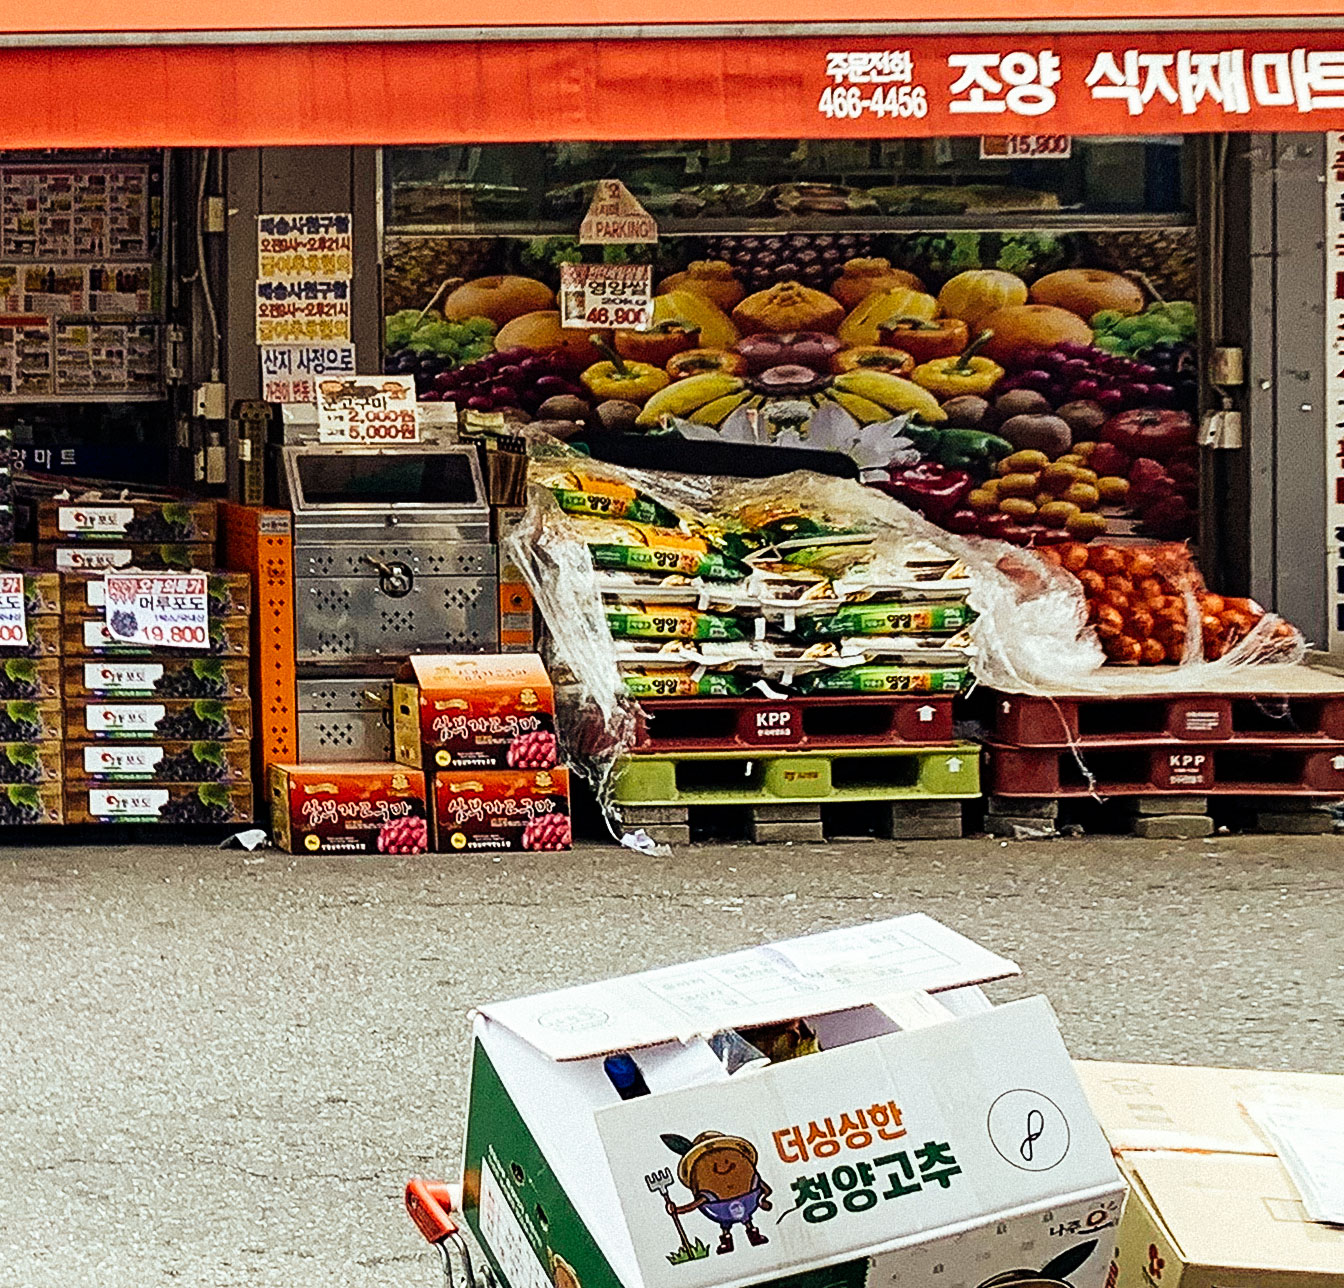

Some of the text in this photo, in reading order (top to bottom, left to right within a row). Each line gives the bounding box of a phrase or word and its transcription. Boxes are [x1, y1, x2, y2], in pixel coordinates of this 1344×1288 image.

[825, 50, 914, 85] 주문전화
[948, 49, 1061, 115] 조양
[818, 85, 928, 119] 466-4456
[596, 221, 649, 238] PARKING
[588, 281, 648, 295] 영양쌀
[264, 348, 354, 374] 산지 사정으로
[140, 596, 204, 611] 머루포도
[141, 626, 205, 643] 19,800
[756, 712, 791, 727] KPP
[1169, 755, 1206, 767] KPP
[772, 1100, 909, 1164] 더싱싱한
[786, 1141, 963, 1224] 청양고추
